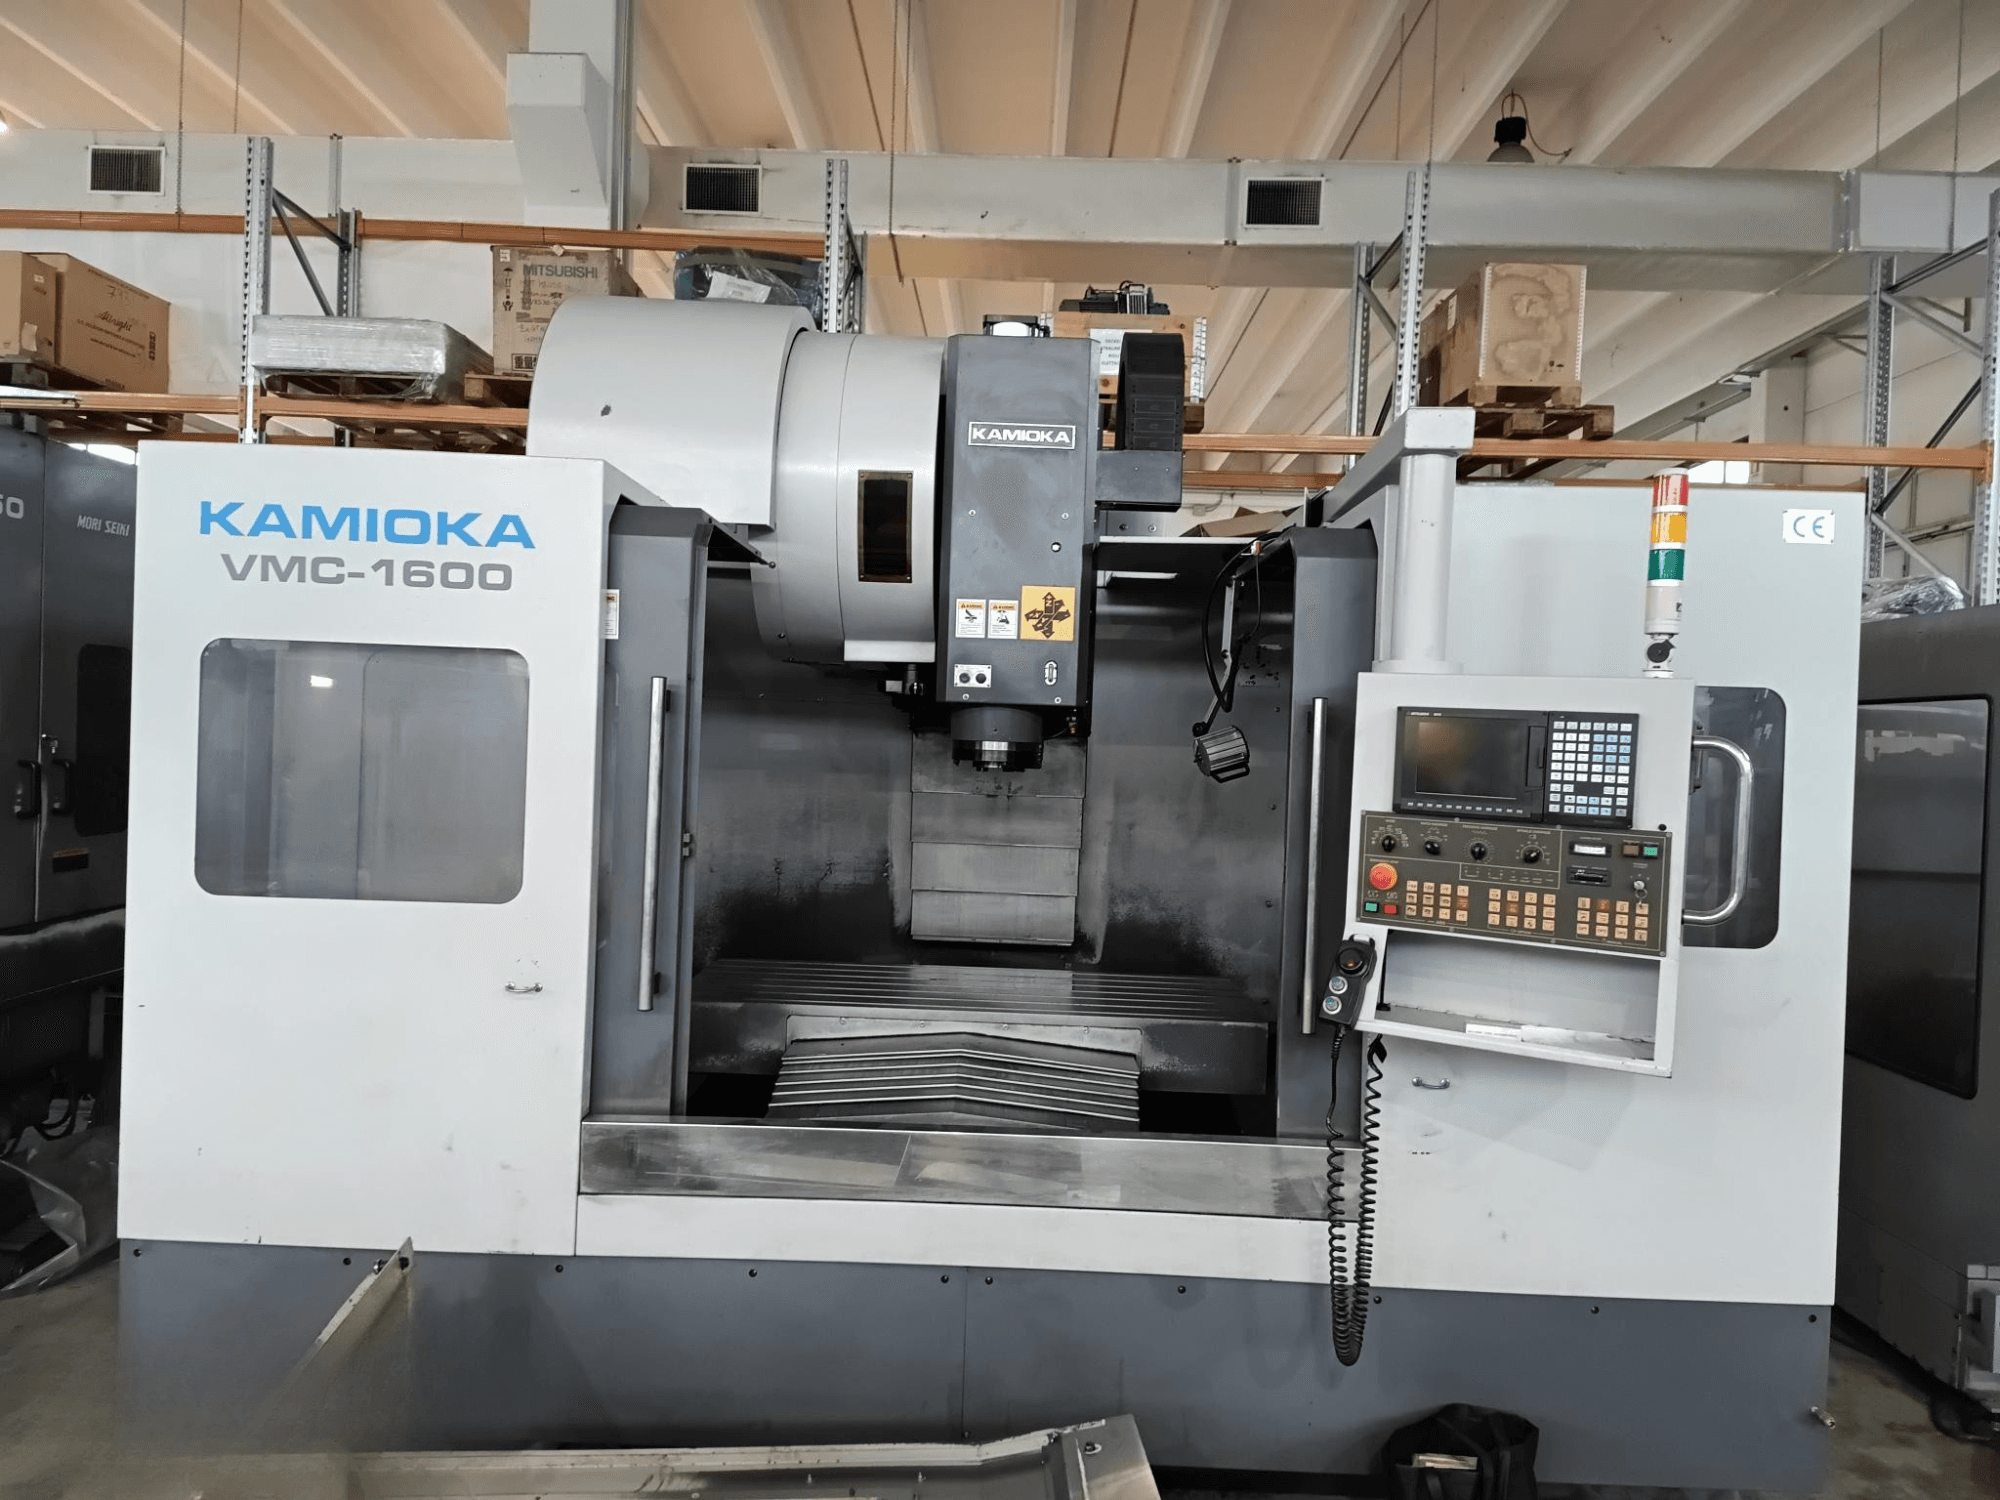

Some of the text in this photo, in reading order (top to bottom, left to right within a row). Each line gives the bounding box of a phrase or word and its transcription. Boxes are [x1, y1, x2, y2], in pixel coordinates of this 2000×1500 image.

[523, 264, 598, 279] MITSUBISHI
[972, 427, 1071, 443] KAMIOKA
[0, 494, 24, 519] 0
[77, 515, 130, 537] MORI SEIKI
[199, 500, 537, 550] KAMIOKA
[1793, 515, 1825, 539] CE
[220, 553, 513, 592] VMC-1600
